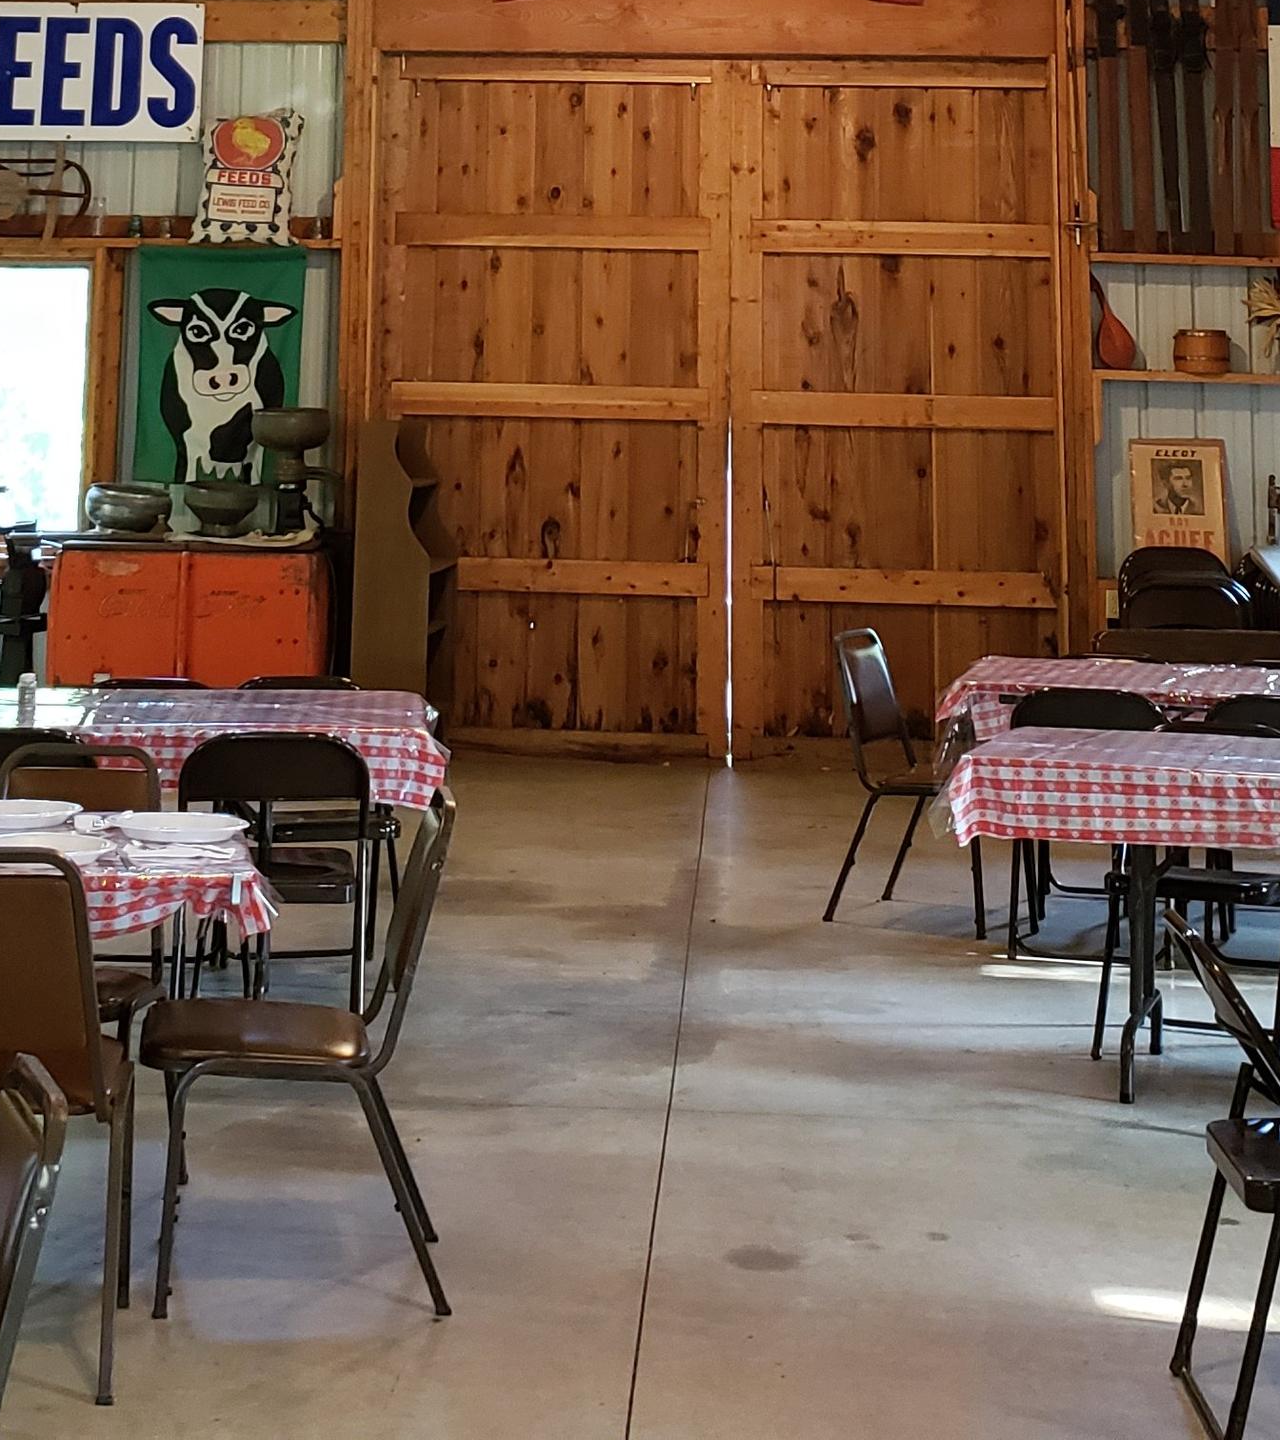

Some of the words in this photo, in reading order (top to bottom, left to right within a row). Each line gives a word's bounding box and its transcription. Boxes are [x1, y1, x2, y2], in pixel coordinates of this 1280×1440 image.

[217, 170, 272, 185] FEEDS
[212, 197, 237, 208] LEWIS
[238, 199, 257, 209] FEED
[1155, 449, 1197, 458] ELECT
